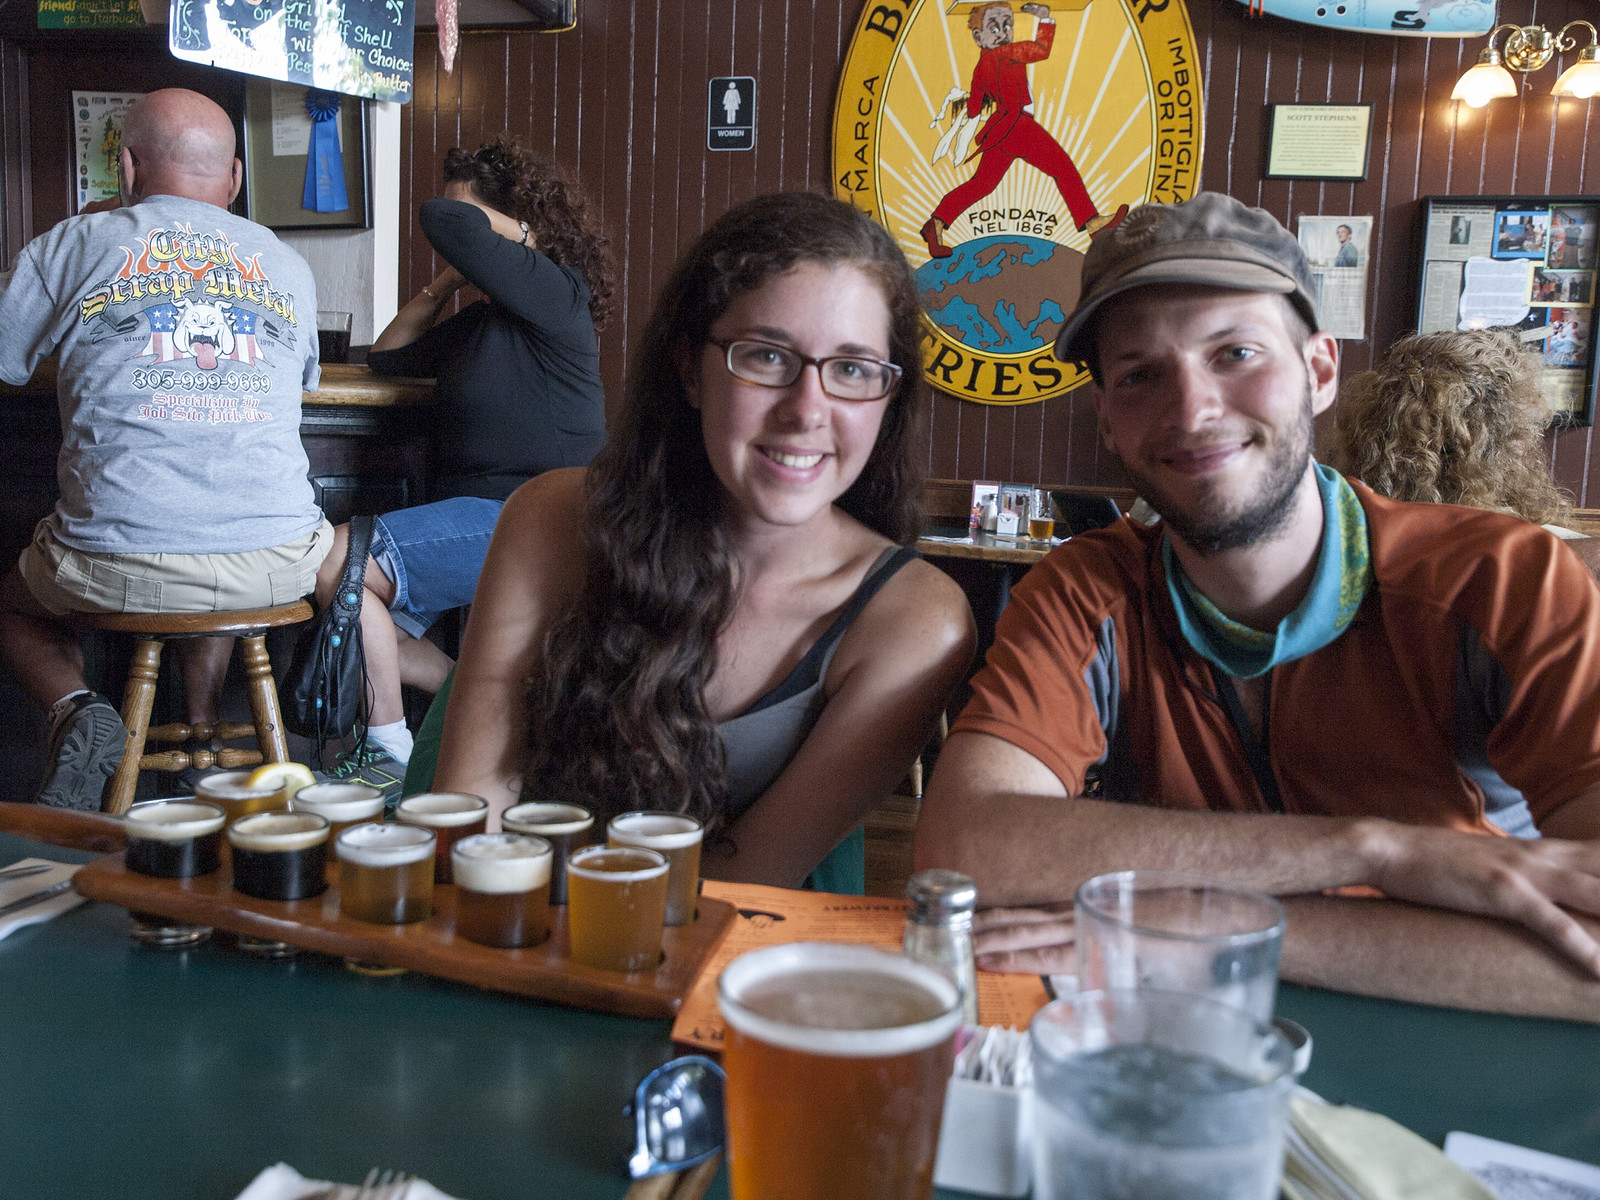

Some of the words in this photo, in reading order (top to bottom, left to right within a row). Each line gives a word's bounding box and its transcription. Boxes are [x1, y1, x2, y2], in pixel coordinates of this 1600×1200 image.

[284, 14, 311, 31] the
[354, 25, 393, 50] Shell
[717, 129, 745, 137] WOMEN
[855, 75, 880, 192] MARCA
[969, 208, 1058, 226] FONDATA
[973, 222, 1007, 237] NEL
[1016, 221, 1055, 236] 1865
[149, 230, 231, 265] City
[82, 269, 194, 325] Scrap
[203, 265, 297, 327] Metal
[131, 368, 273, 394] 305-999-9669
[153, 391, 238, 409] Specializing
[241, 394, 259, 408] In
[138, 404, 167, 421] Job
[171, 406, 204, 421] Site
